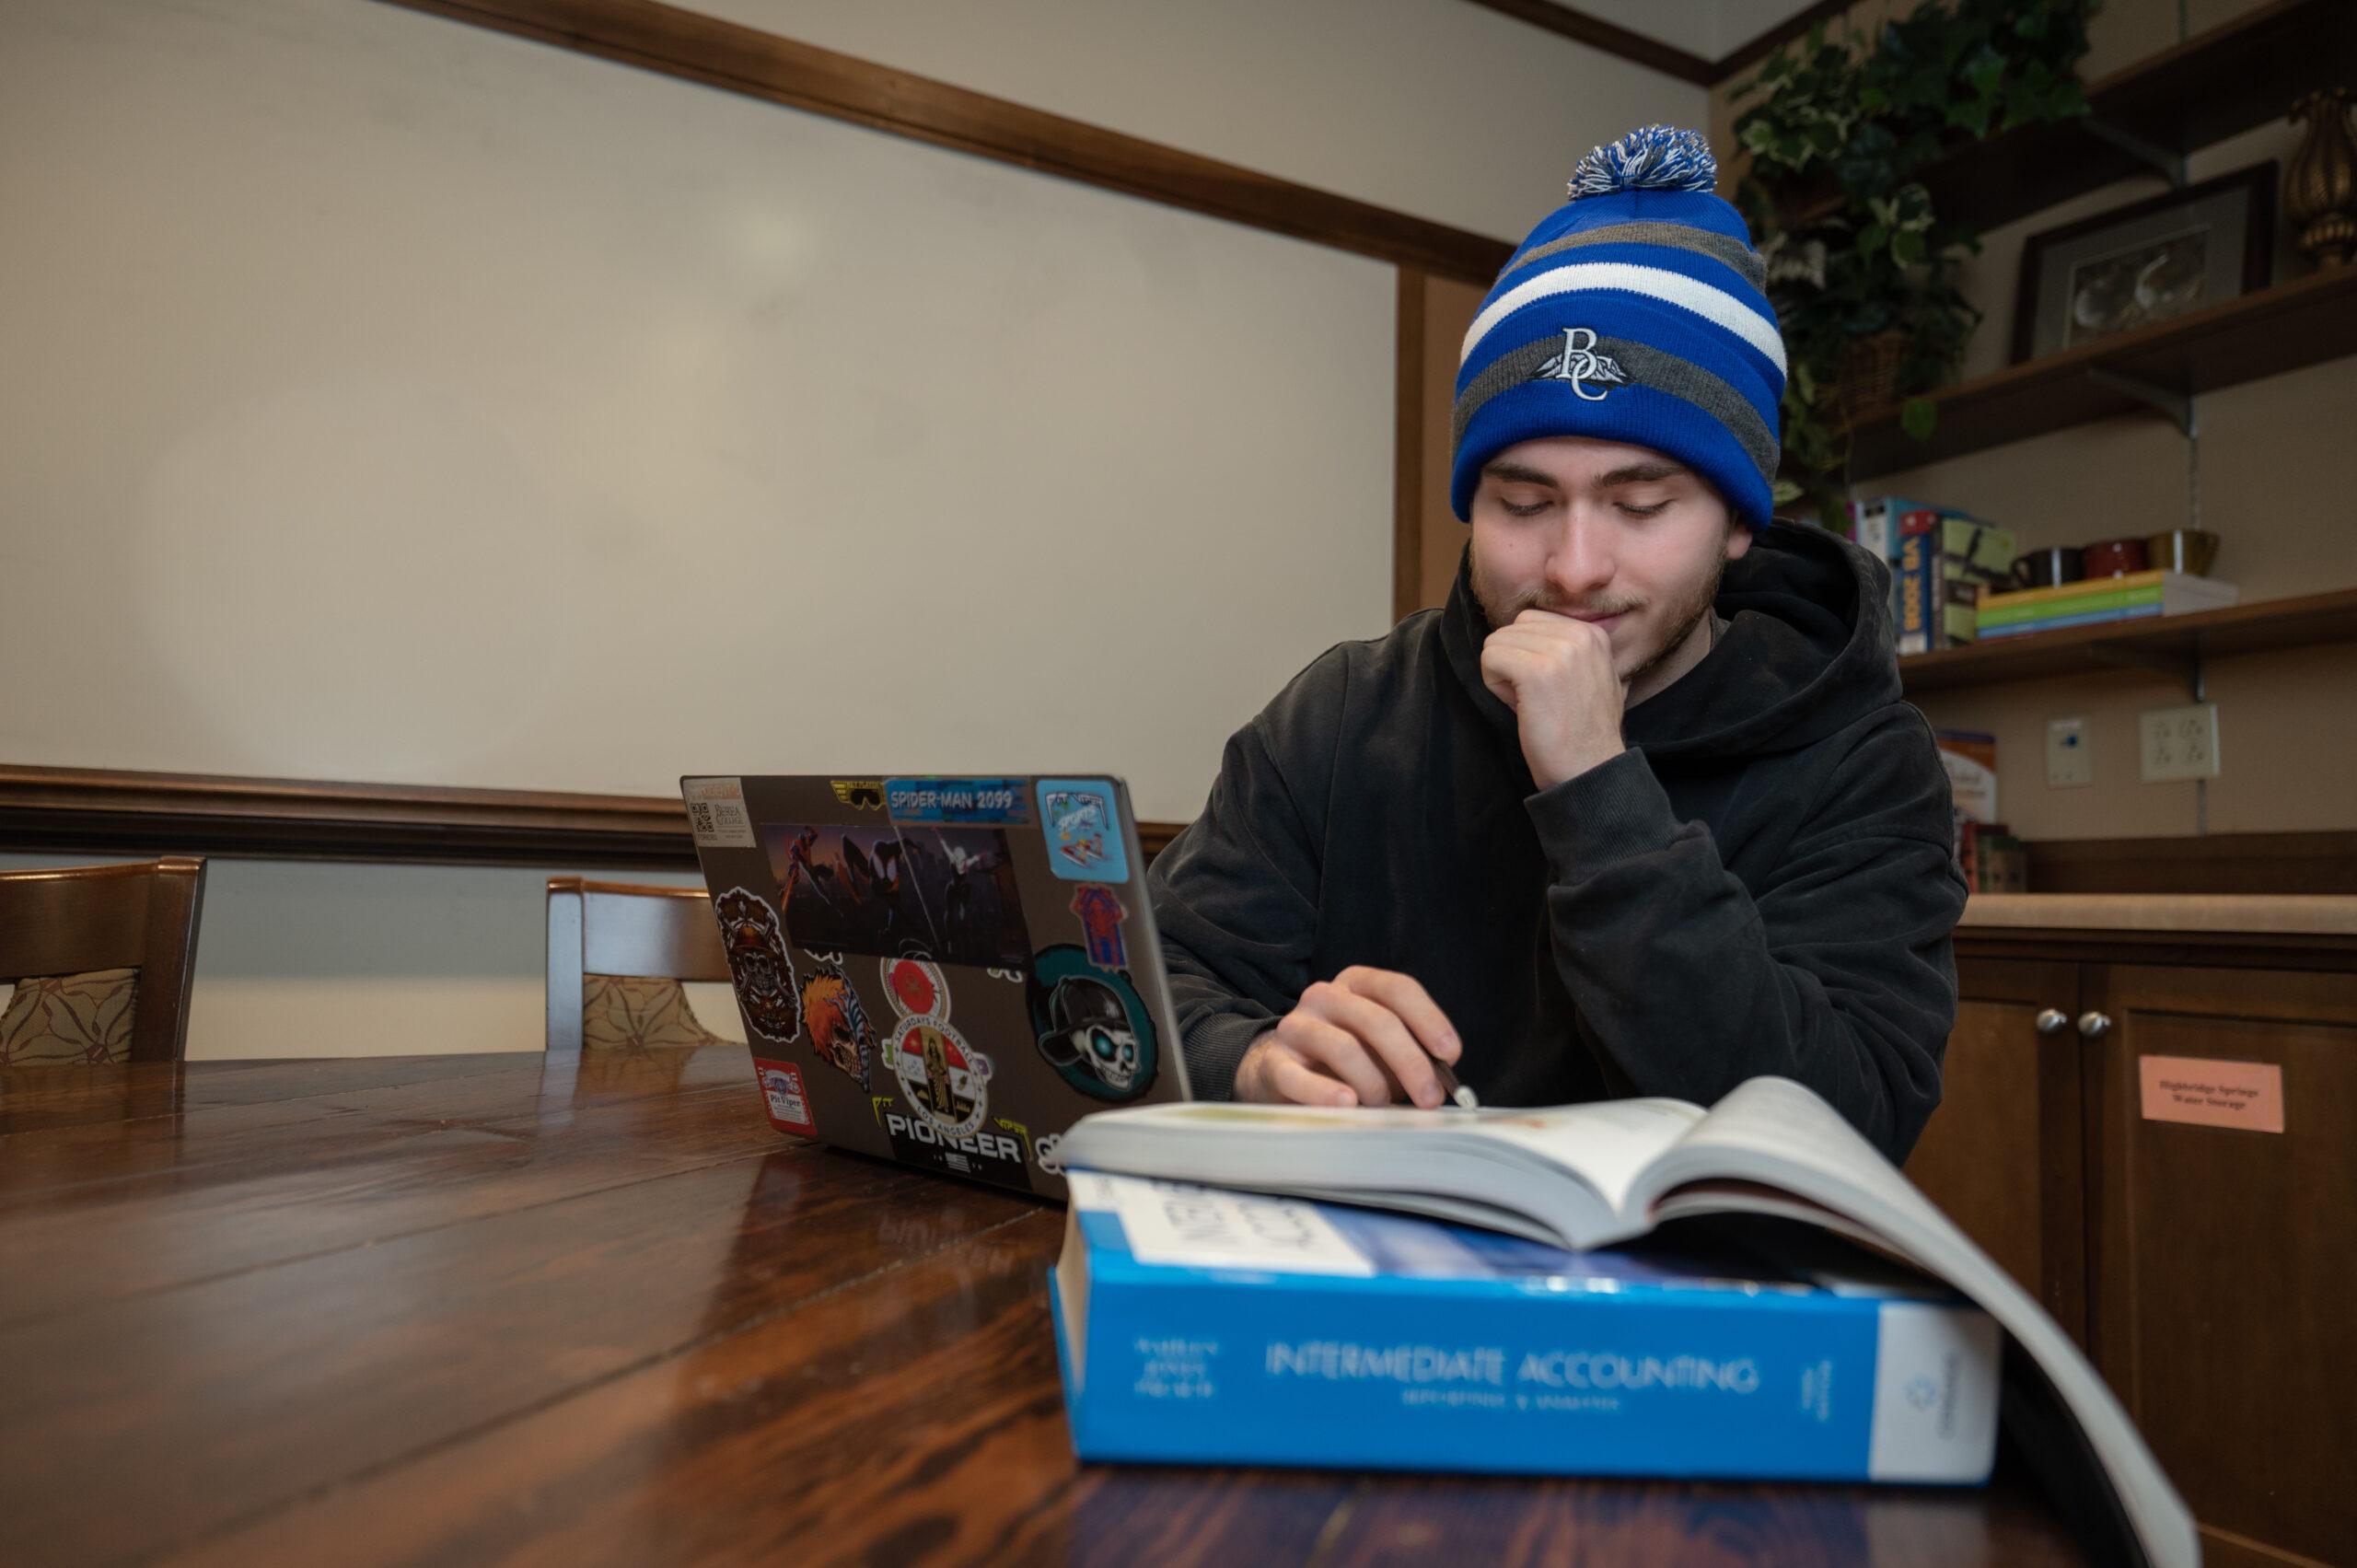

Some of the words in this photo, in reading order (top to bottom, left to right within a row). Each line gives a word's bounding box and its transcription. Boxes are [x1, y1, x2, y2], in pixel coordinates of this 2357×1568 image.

[890, 790, 973, 809] SPIDER-MAN
[977, 790, 1012, 809] 2099
[895, 1016, 931, 1040] SATURDAYS
[933, 1020, 973, 1063] FOOTBALL
[917, 1106, 934, 1124] LOS
[937, 1121, 975, 1136] ANGELES
[1265, 1339, 1504, 1383] INTERMEDIATE
[1515, 1350, 1759, 1394] ACCOUNTING
